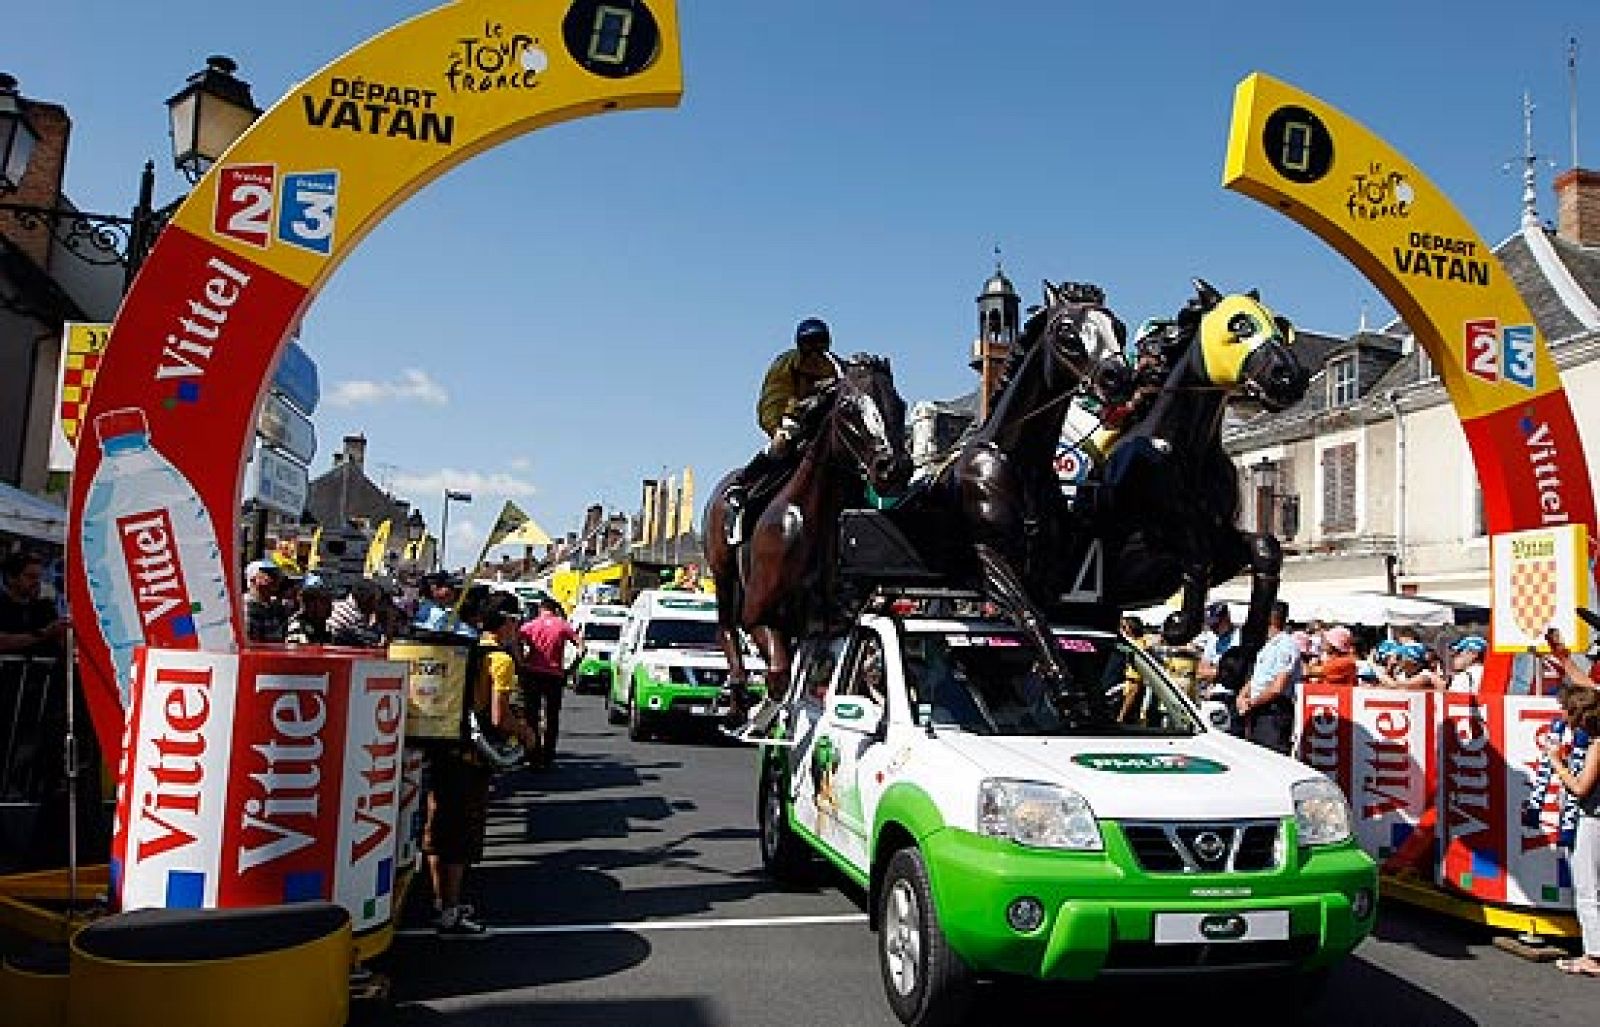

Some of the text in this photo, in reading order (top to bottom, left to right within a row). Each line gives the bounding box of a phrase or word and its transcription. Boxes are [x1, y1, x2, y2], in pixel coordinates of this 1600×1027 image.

[587, 5, 632, 64] 0
[303, 95, 455, 146] VATAN
[331, 76, 437, 108] DÉPART
[1282, 121, 1313, 172] 0
[227, 185, 274, 232] 2
[291, 191, 336, 239] 3
[1394, 247, 1490, 286] VATAN
[155, 256, 251, 380] Vittel
[1472, 334, 1499, 373] 2
[1510, 340, 1536, 377] 3
[1527, 422, 1569, 524] Vittel
[124, 514, 184, 626] Vittel
[137, 666, 213, 865] Vittel
[351, 676, 404, 866] Vittel
[1306, 694, 1339, 778] ttel
[1363, 698, 1412, 820] Vittel
[1447, 704, 1490, 838] Vittel
[238, 672, 331, 875] Vittel
